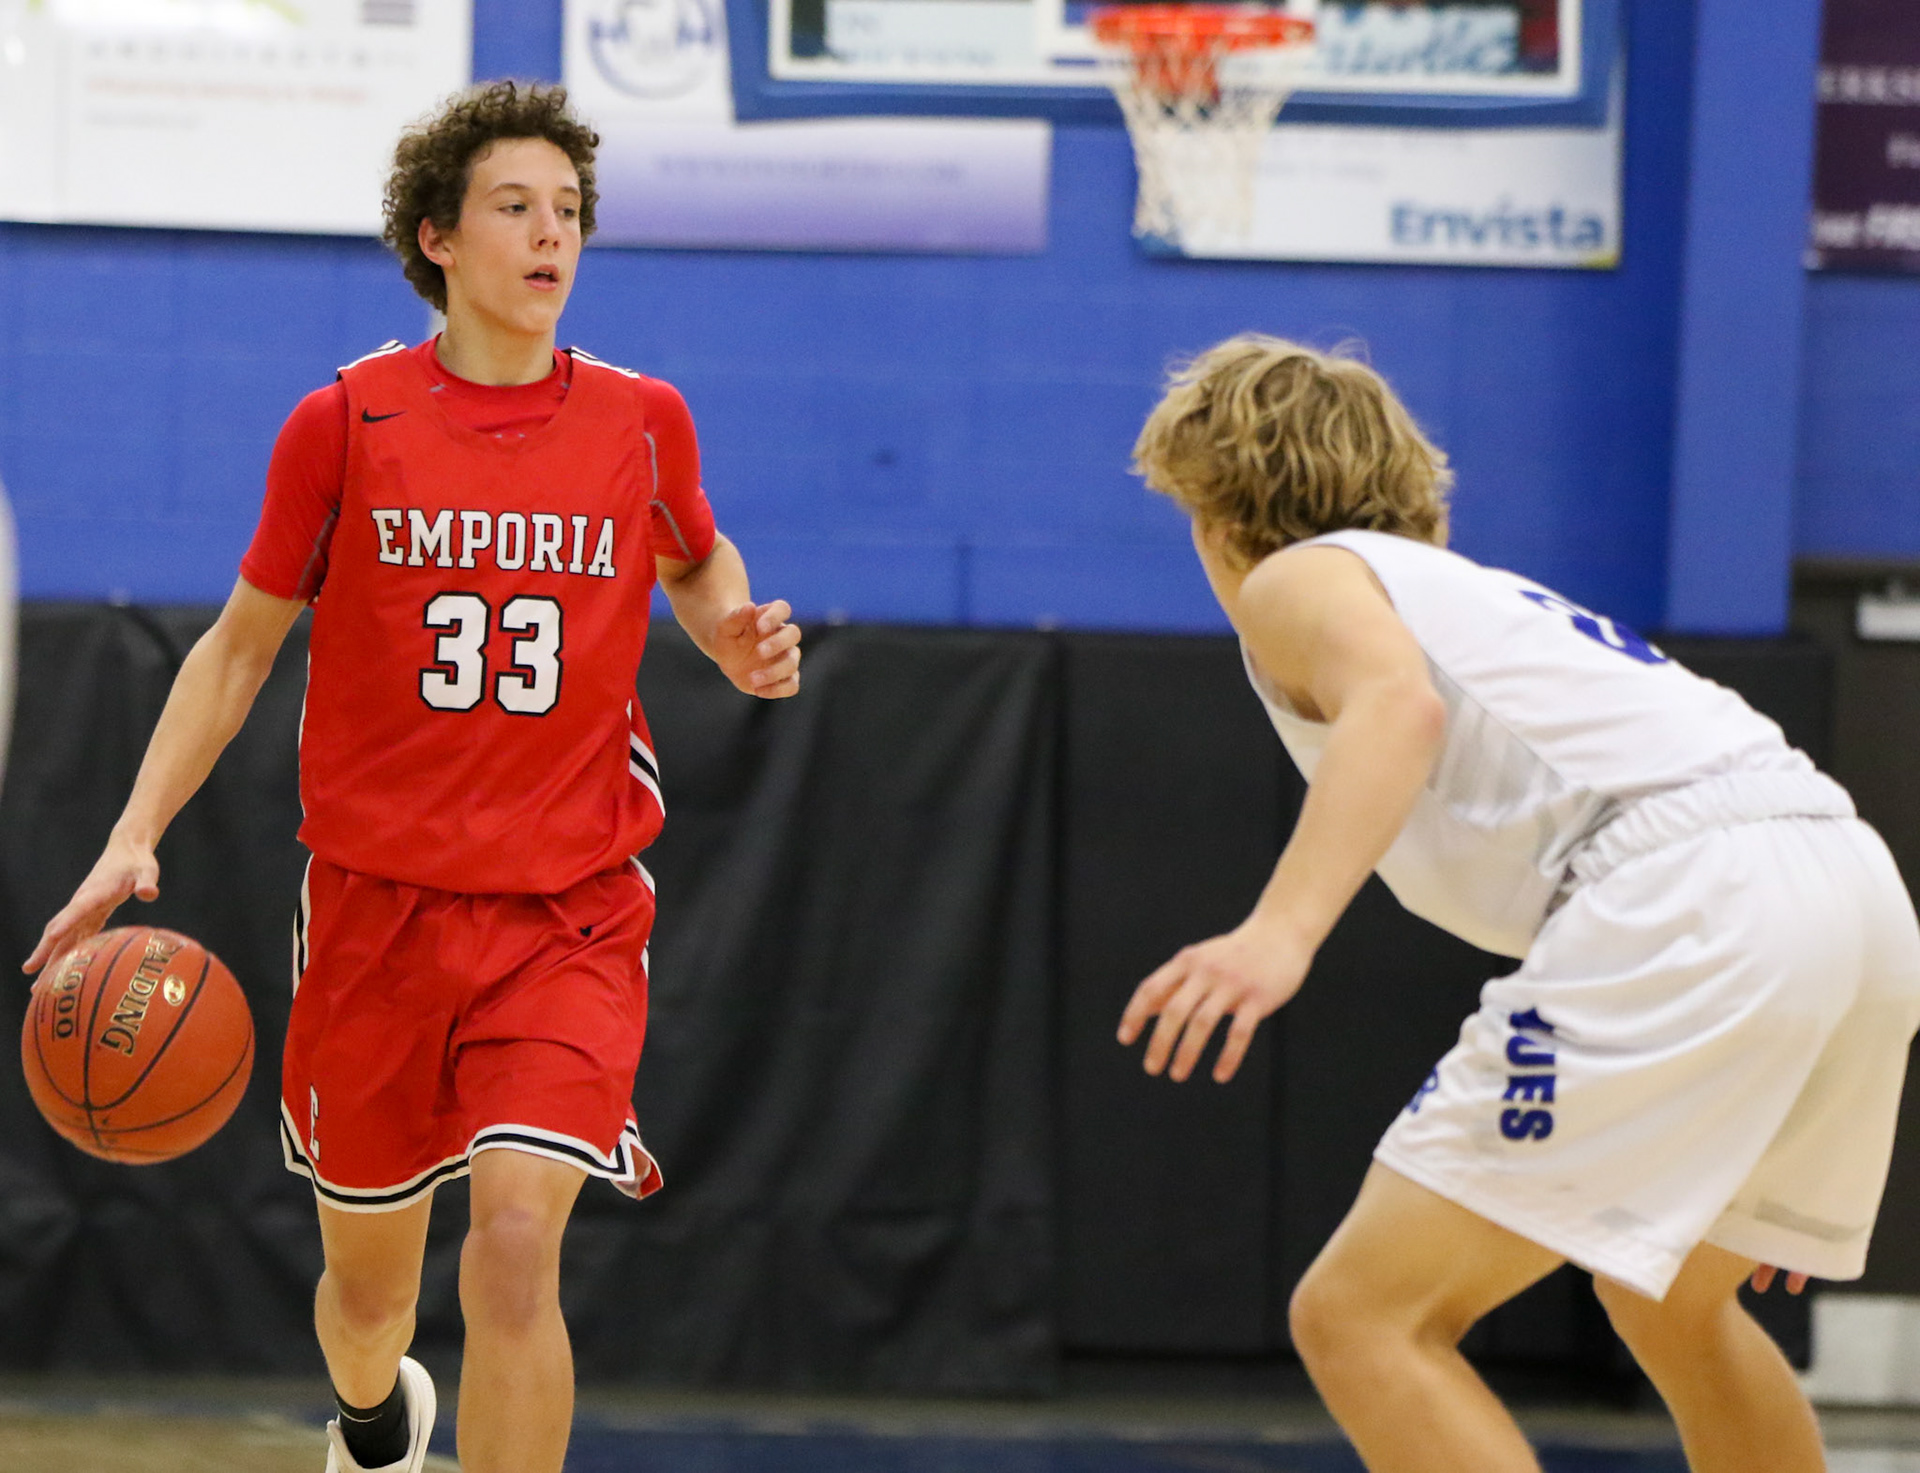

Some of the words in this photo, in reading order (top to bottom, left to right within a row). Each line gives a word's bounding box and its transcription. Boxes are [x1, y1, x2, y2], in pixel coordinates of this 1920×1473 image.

[1391, 198, 1605, 247] Envista
[371, 509, 616, 577] EMPORIA
[419, 591, 563, 717] 33
[100, 930, 184, 1057] PALDING
